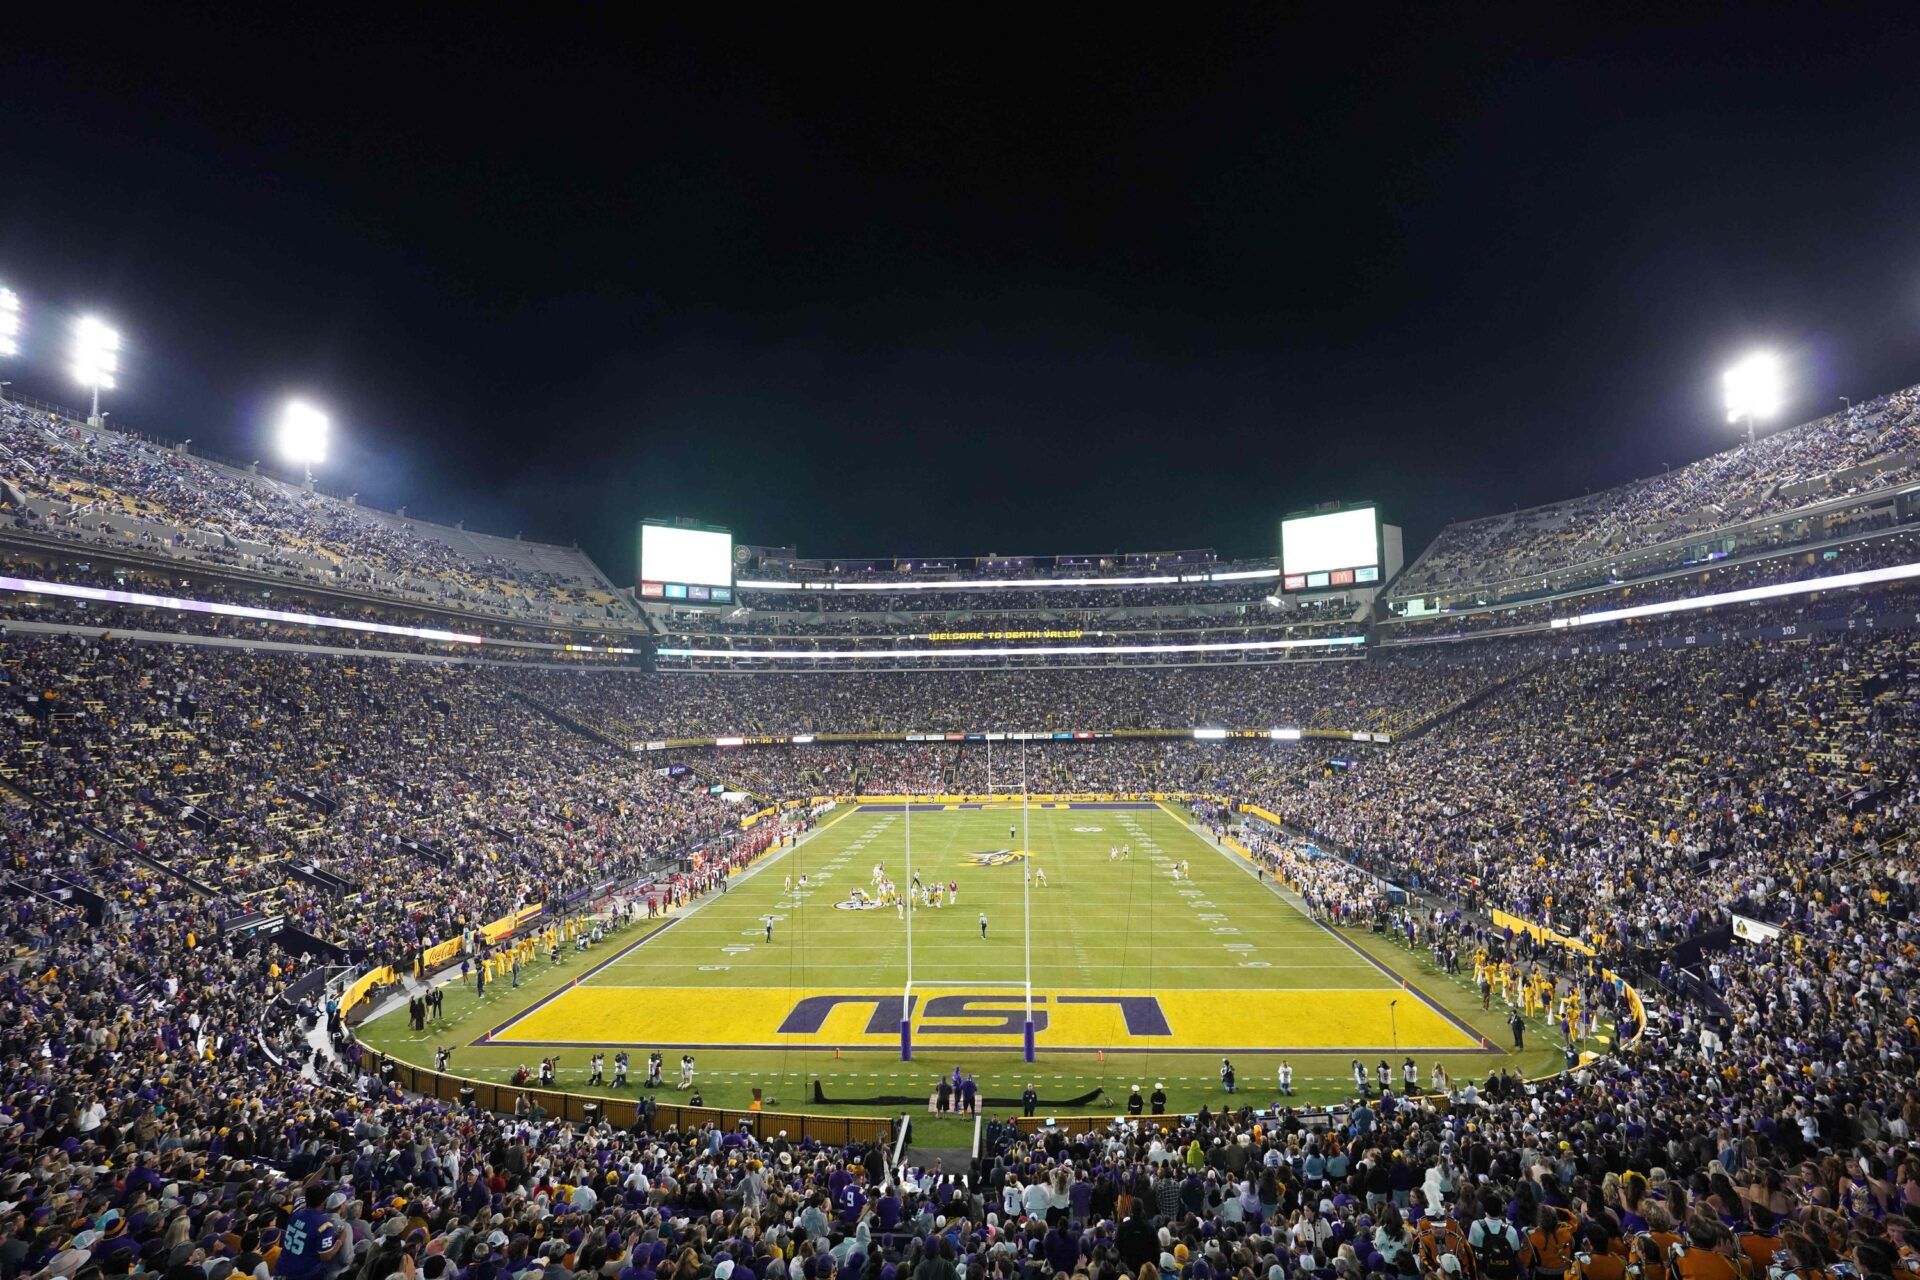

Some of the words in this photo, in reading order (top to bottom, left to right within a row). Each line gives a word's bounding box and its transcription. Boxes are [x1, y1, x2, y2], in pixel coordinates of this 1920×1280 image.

[928, 632, 984, 641] WELCOME
[988, 632, 1002, 640] TO
[1005, 631, 1040, 640] DEATH
[1043, 630, 1083, 639] VALLEY
[1782, 626, 1796, 635] 103
[776, 995, 1173, 1036] LSU
[702, 1172, 707, 1180] 7
[847, 1192, 854, 1206] 9
[1009, 1197, 1013, 1208] 1
[284, 1224, 307, 1255] 55
[321, 1236, 333, 1249] 55
